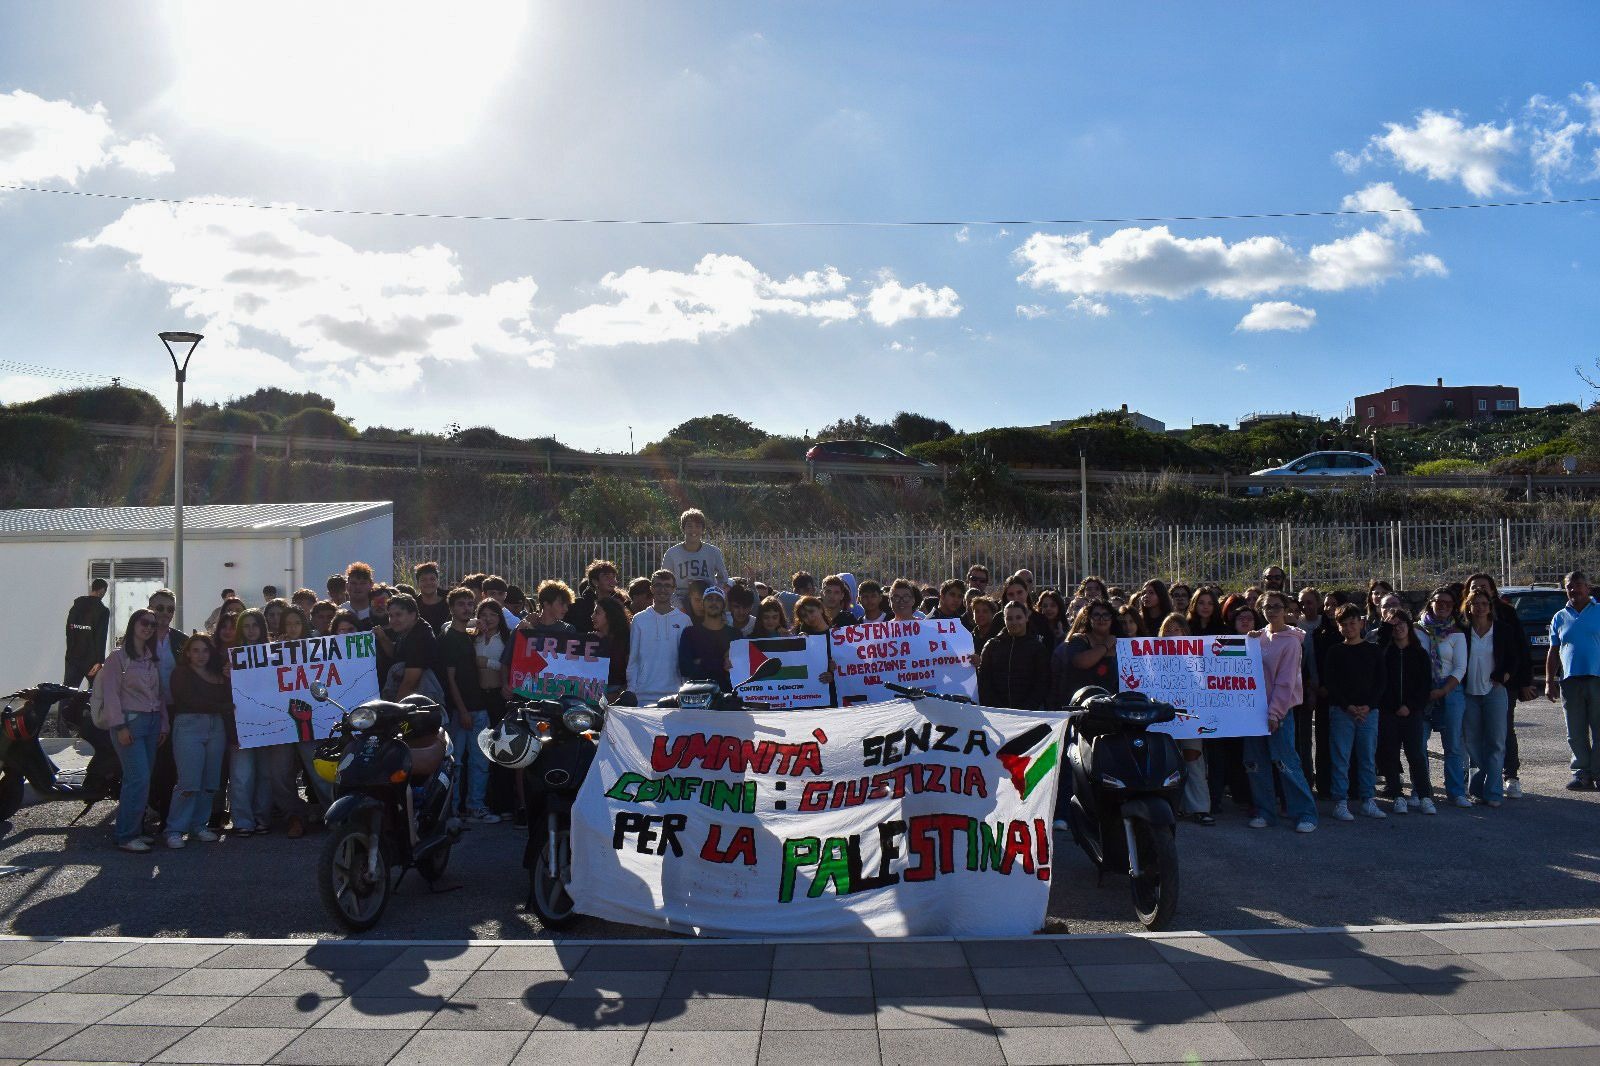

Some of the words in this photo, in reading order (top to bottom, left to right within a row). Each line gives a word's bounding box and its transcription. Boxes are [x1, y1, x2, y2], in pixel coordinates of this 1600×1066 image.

[678, 559, 710, 579] USA
[831, 620, 921, 645] SOSTENIAMO
[937, 621, 956, 634] LA
[231, 637, 342, 670] GIUSTIZIA
[345, 632, 376, 659] PER
[525, 637, 600, 662] FREE
[857, 640, 910, 659] CAUSA
[929, 640, 947, 652] DI
[1131, 639, 1204, 656] BAMBINI
[837, 659, 906, 677] LIBERAZIONE
[911, 658, 930, 669] DEI
[1185, 656, 1253, 675] SENTIRE
[277, 662, 342, 692] GAZA
[863, 675, 883, 685] NEL
[1124, 674, 1187, 690] RLARE
[1207, 675, 1257, 690] GUERRA
[650, 728, 828, 776] UMANITÀ
[863, 723, 990, 767] SENZA
[604, 771, 757, 813] CONFINI
[798, 763, 988, 811] GIUSTIZIA
[613, 812, 688, 857] PER
[700, 824, 757, 865] LA
[778, 813, 1050, 903] PALESTINA!
